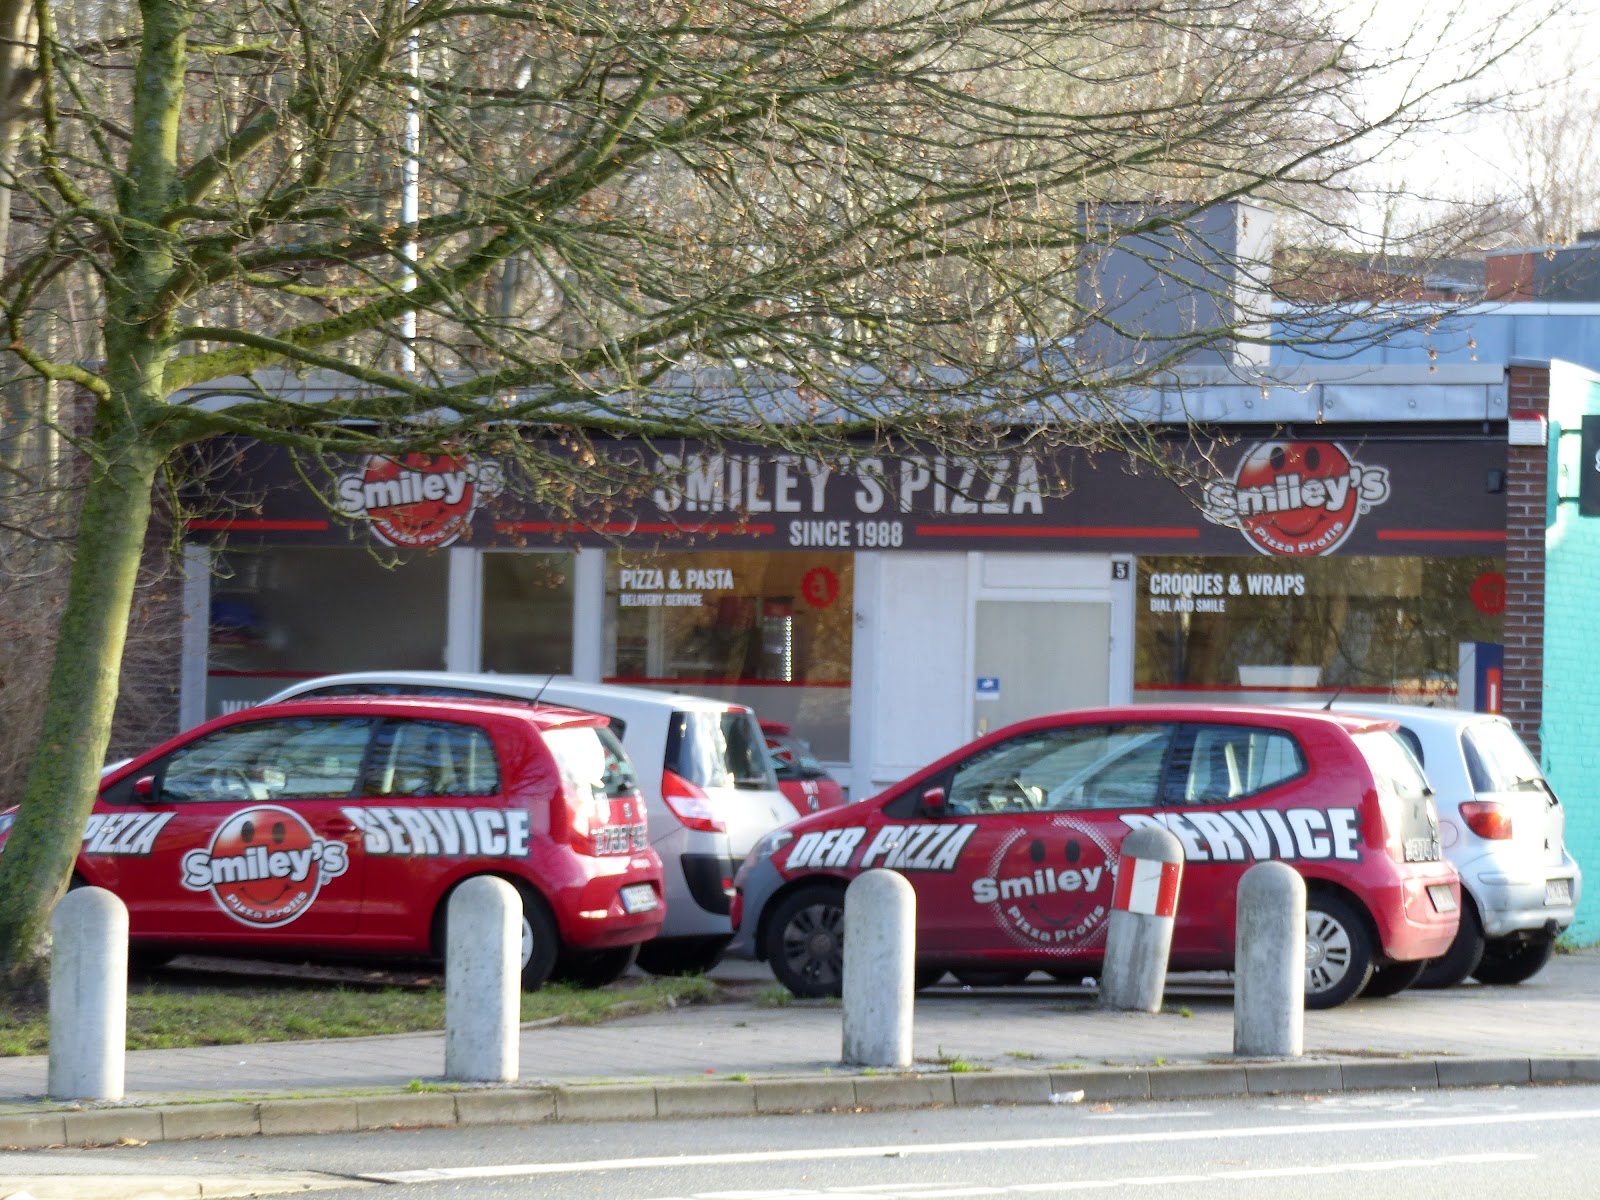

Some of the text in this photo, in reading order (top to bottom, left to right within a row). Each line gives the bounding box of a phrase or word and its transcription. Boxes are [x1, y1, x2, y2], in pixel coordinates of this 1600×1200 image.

[338, 461, 502, 512] Smiley's
[653, 453, 1043, 514] SMILEY'S PIZZA
[1207, 470, 1386, 521] Smiley's
[789, 520, 904, 548] SINCE 1988
[1253, 521, 1344, 554] Pizza Profis
[620, 568, 735, 590] PIZZA & PASTA
[1115, 563, 1126, 579] 5
[1150, 573, 1305, 598] CROQUES & WRAPS
[1150, 598, 1226, 613] DIAL AND SMILE
[340, 806, 530, 857] SERVICE
[784, 823, 979, 870] DER PIZZA
[184, 841, 347, 887] Smiley's
[971, 860, 1118, 904] Smiley'
[226, 893, 263, 919] Pizza
[1007, 904, 1104, 942] Pizza Profis
